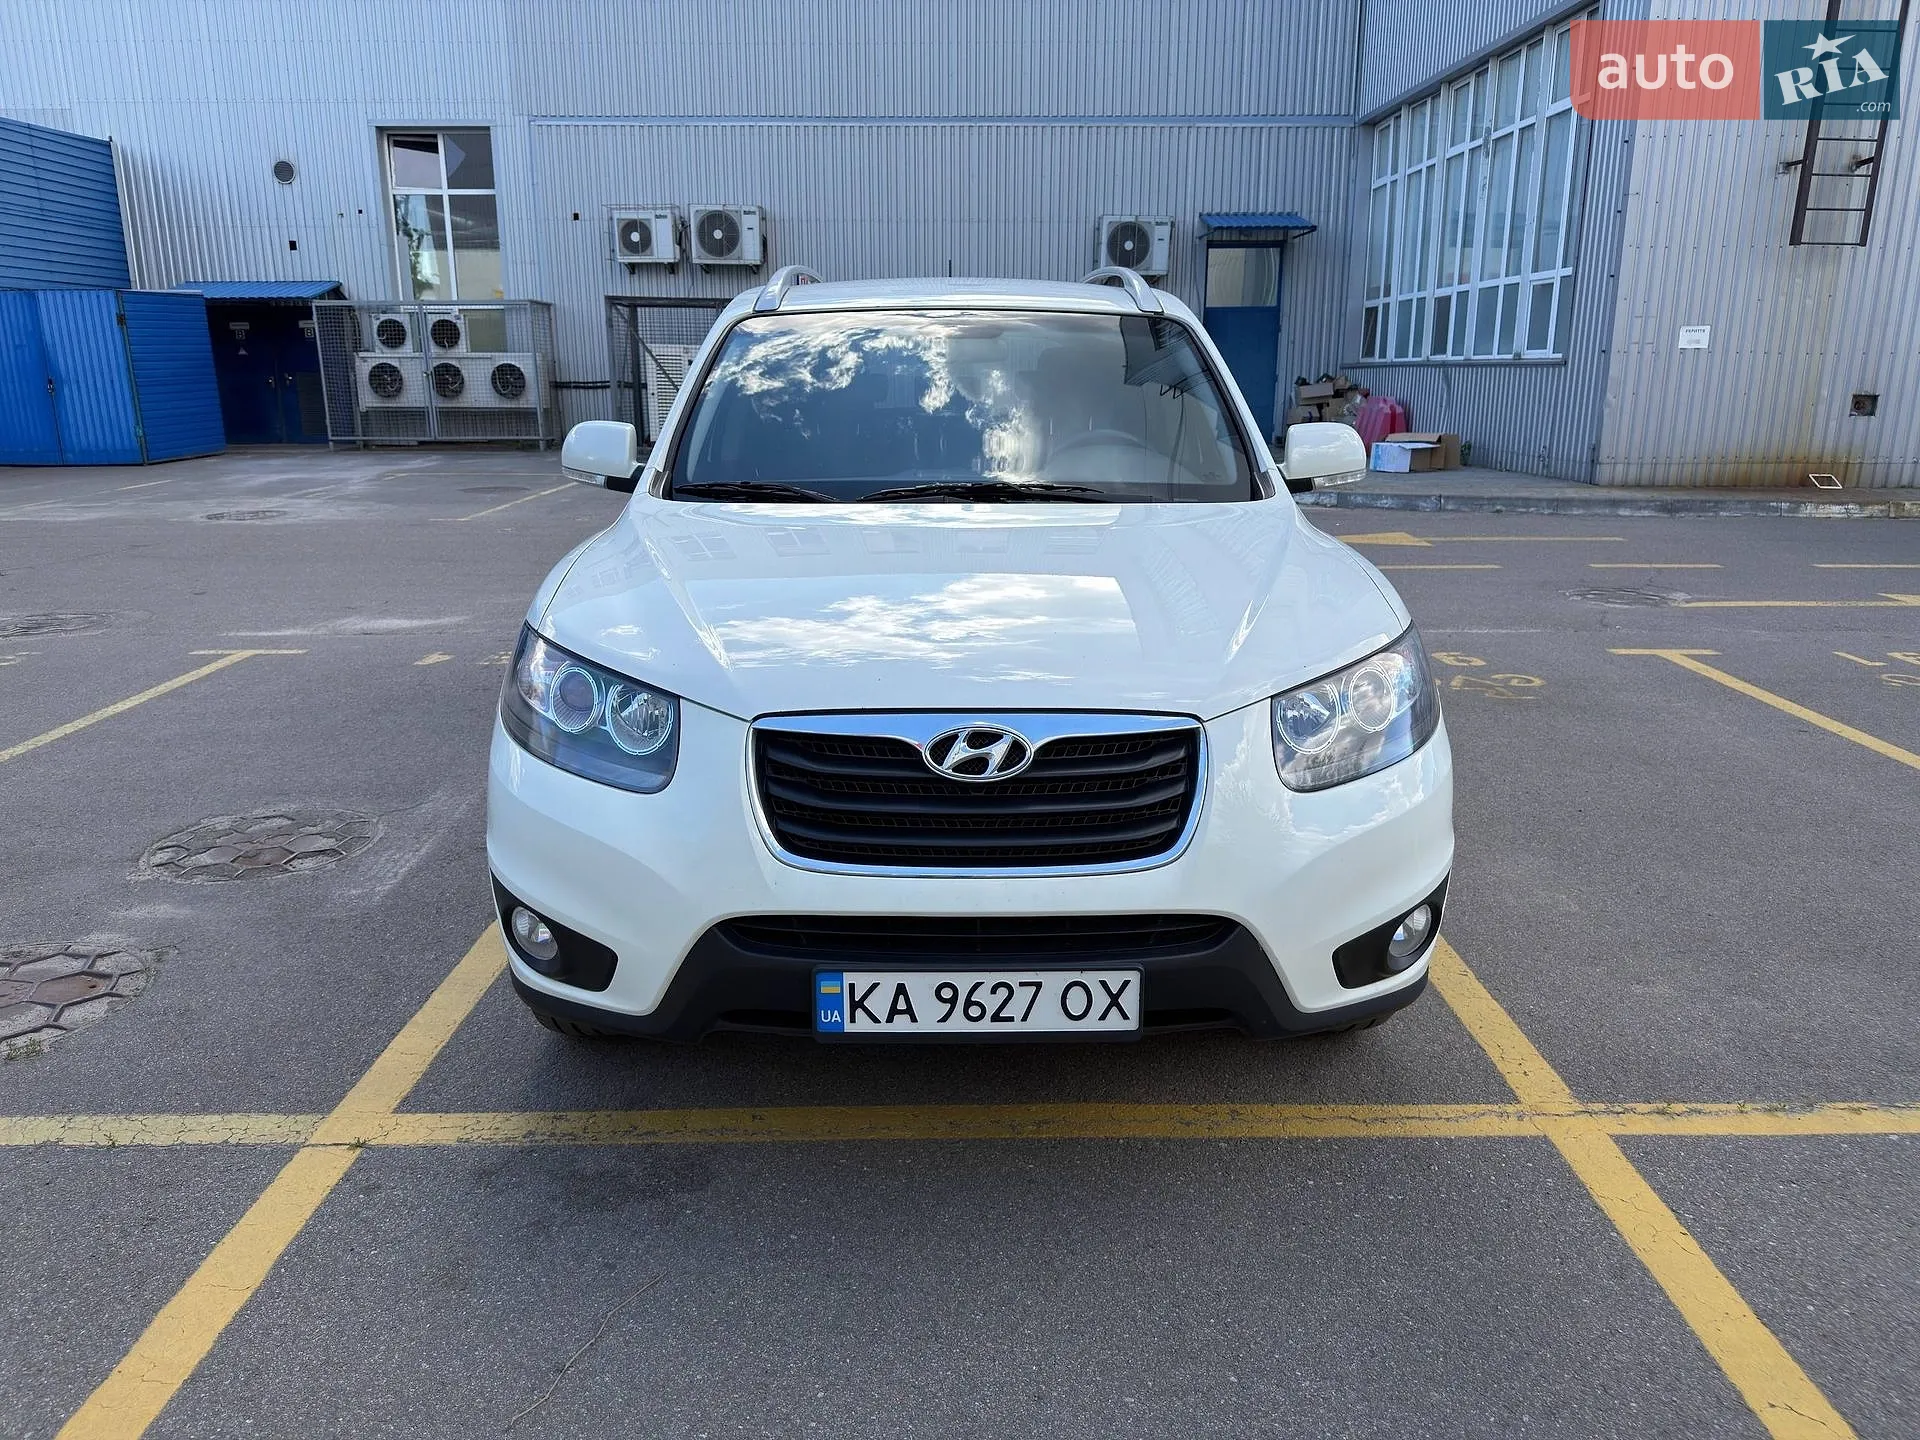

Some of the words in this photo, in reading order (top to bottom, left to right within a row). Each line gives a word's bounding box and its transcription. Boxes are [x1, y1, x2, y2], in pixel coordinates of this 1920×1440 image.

[848, 982, 919, 1024] KA
[935, 981, 1043, 1023] 9627
[1060, 979, 1132, 1021] OX
[821, 1010, 842, 1023] UA
